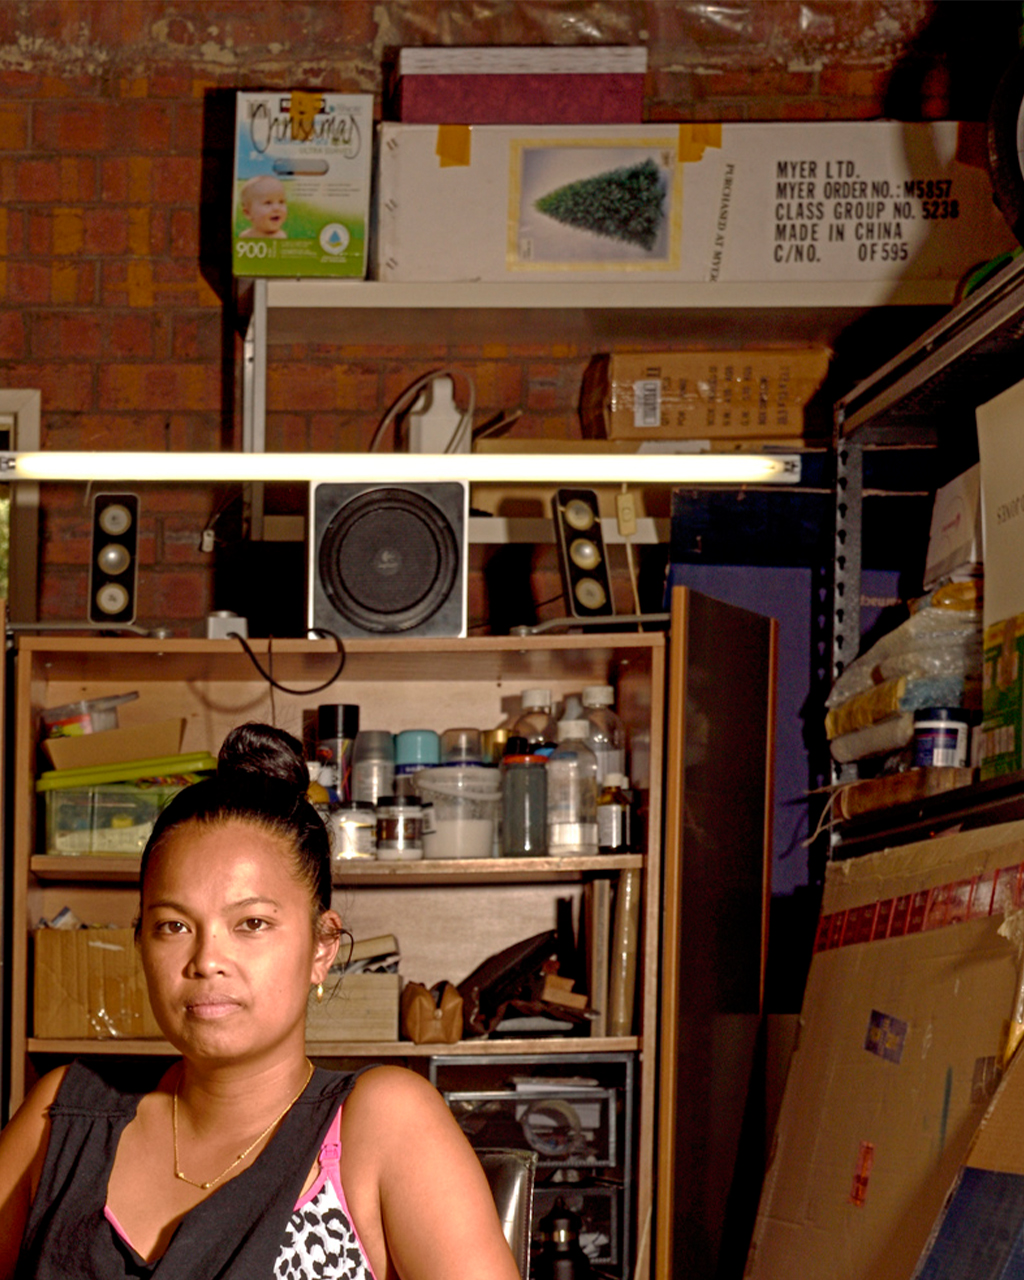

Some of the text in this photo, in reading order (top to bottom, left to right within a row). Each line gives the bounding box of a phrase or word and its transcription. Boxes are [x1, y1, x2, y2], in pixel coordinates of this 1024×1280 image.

[776, 160, 861, 179] MYER LTD.
[717, 163, 736, 231] PURCHASED
[775, 181, 816, 200] MYER
[824, 180, 868, 199] ORDER
[904, 179, 953, 199] M5857
[775, 199, 960, 221] CLASS GROUP NO. 5238
[714, 233, 725, 248] AT
[774, 222, 903, 242] MADE IN CHINA
[236, 241, 267, 259] 900
[773, 244, 821, 264] C/NO.
